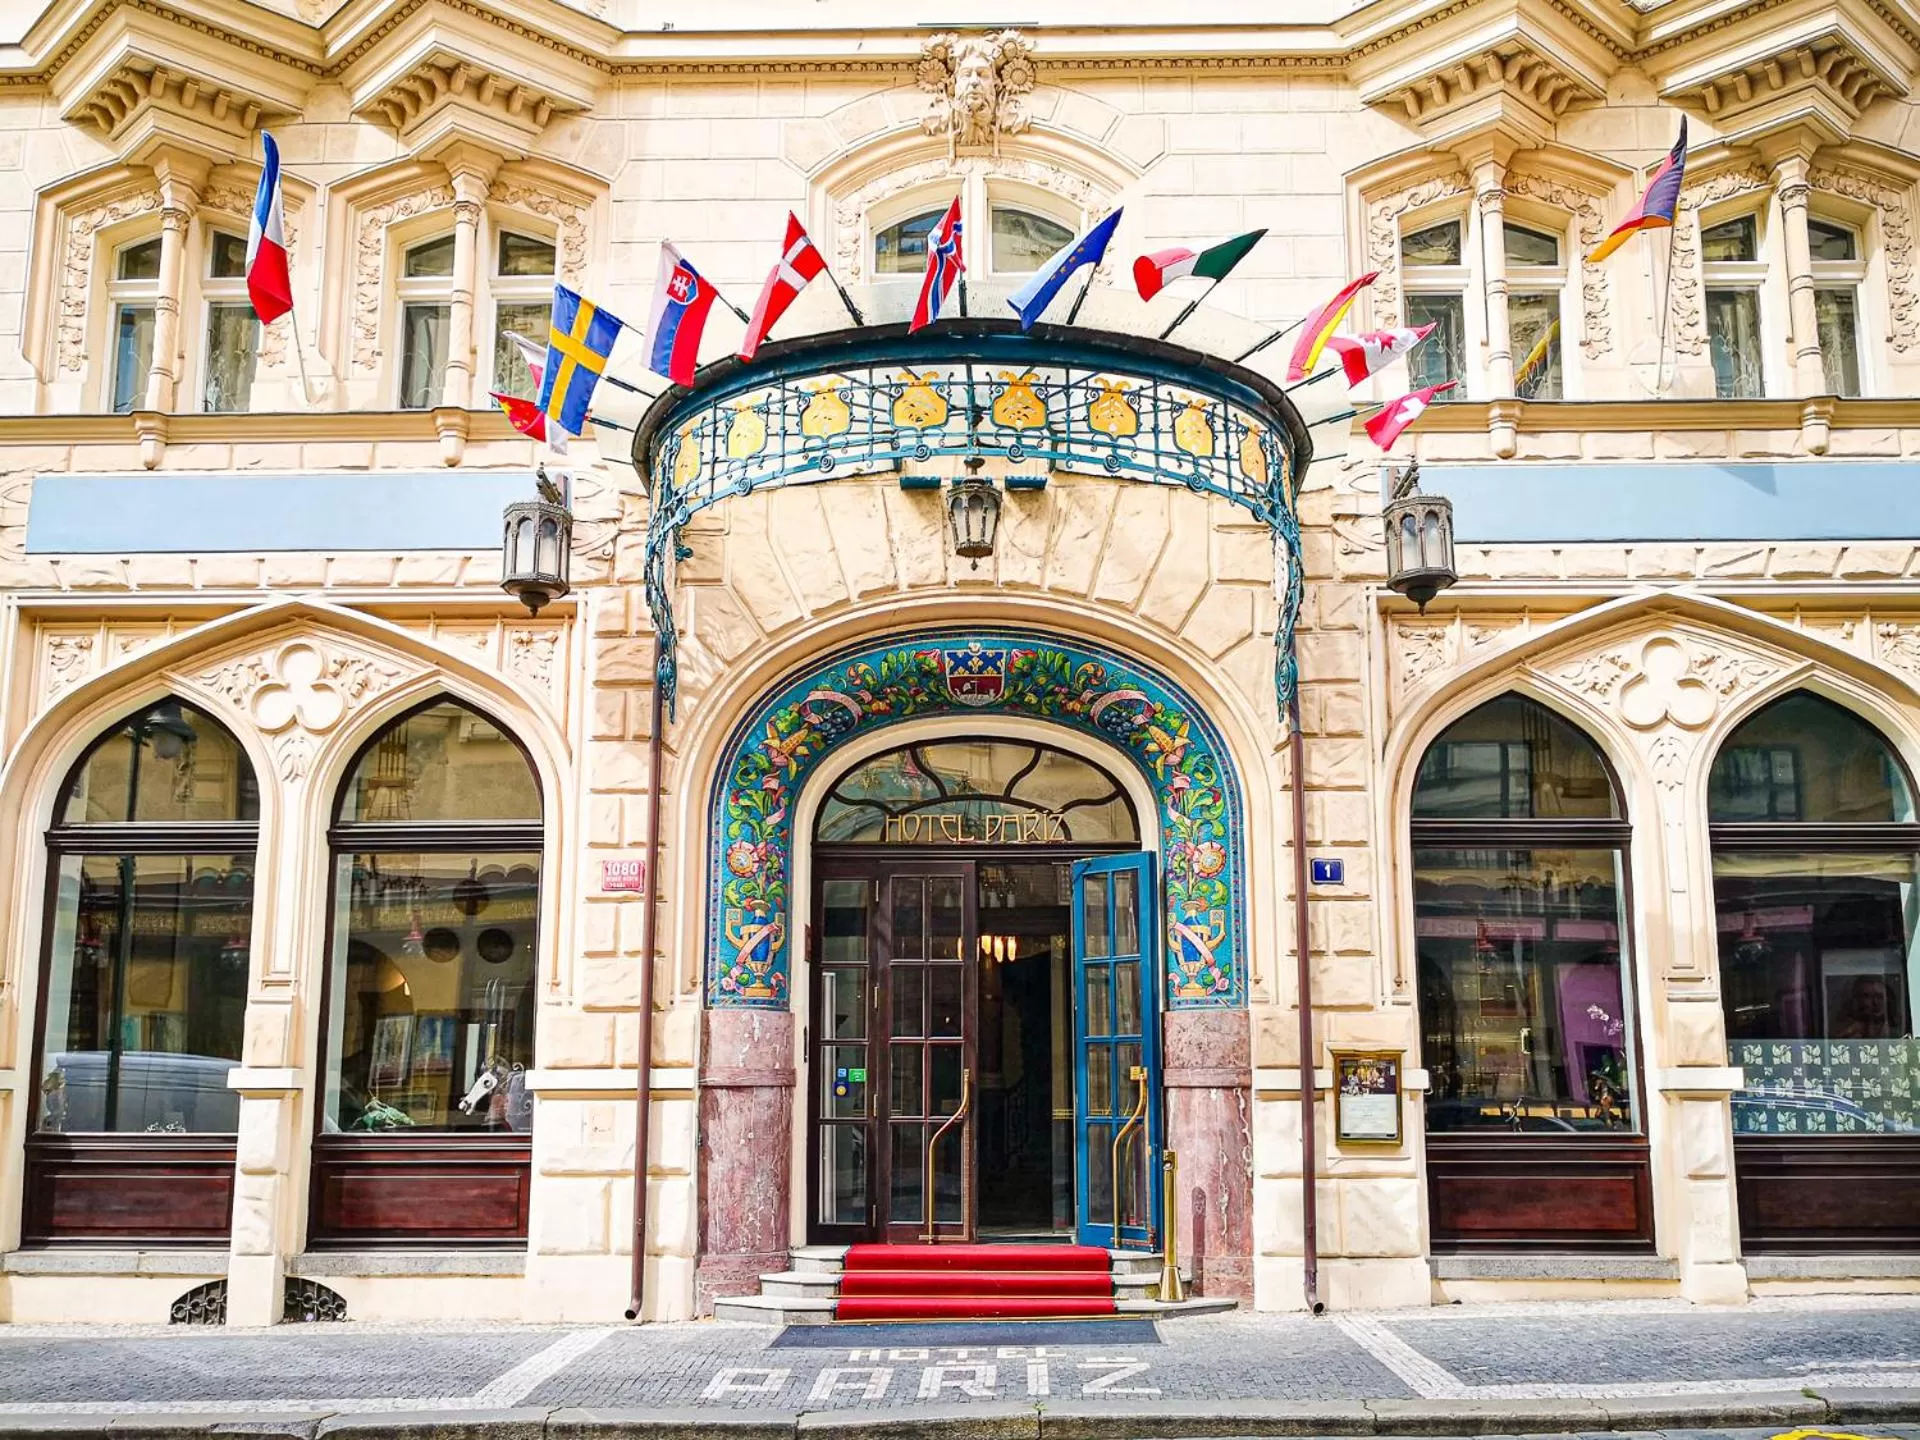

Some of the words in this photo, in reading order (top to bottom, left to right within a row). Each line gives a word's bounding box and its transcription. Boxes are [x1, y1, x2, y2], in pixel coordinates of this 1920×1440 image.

[885, 813, 975, 843] HOTEL
[605, 862, 638, 876] 1080
[1325, 864, 1330, 878] 1
[848, 1347, 1067, 1361] HOTEL
